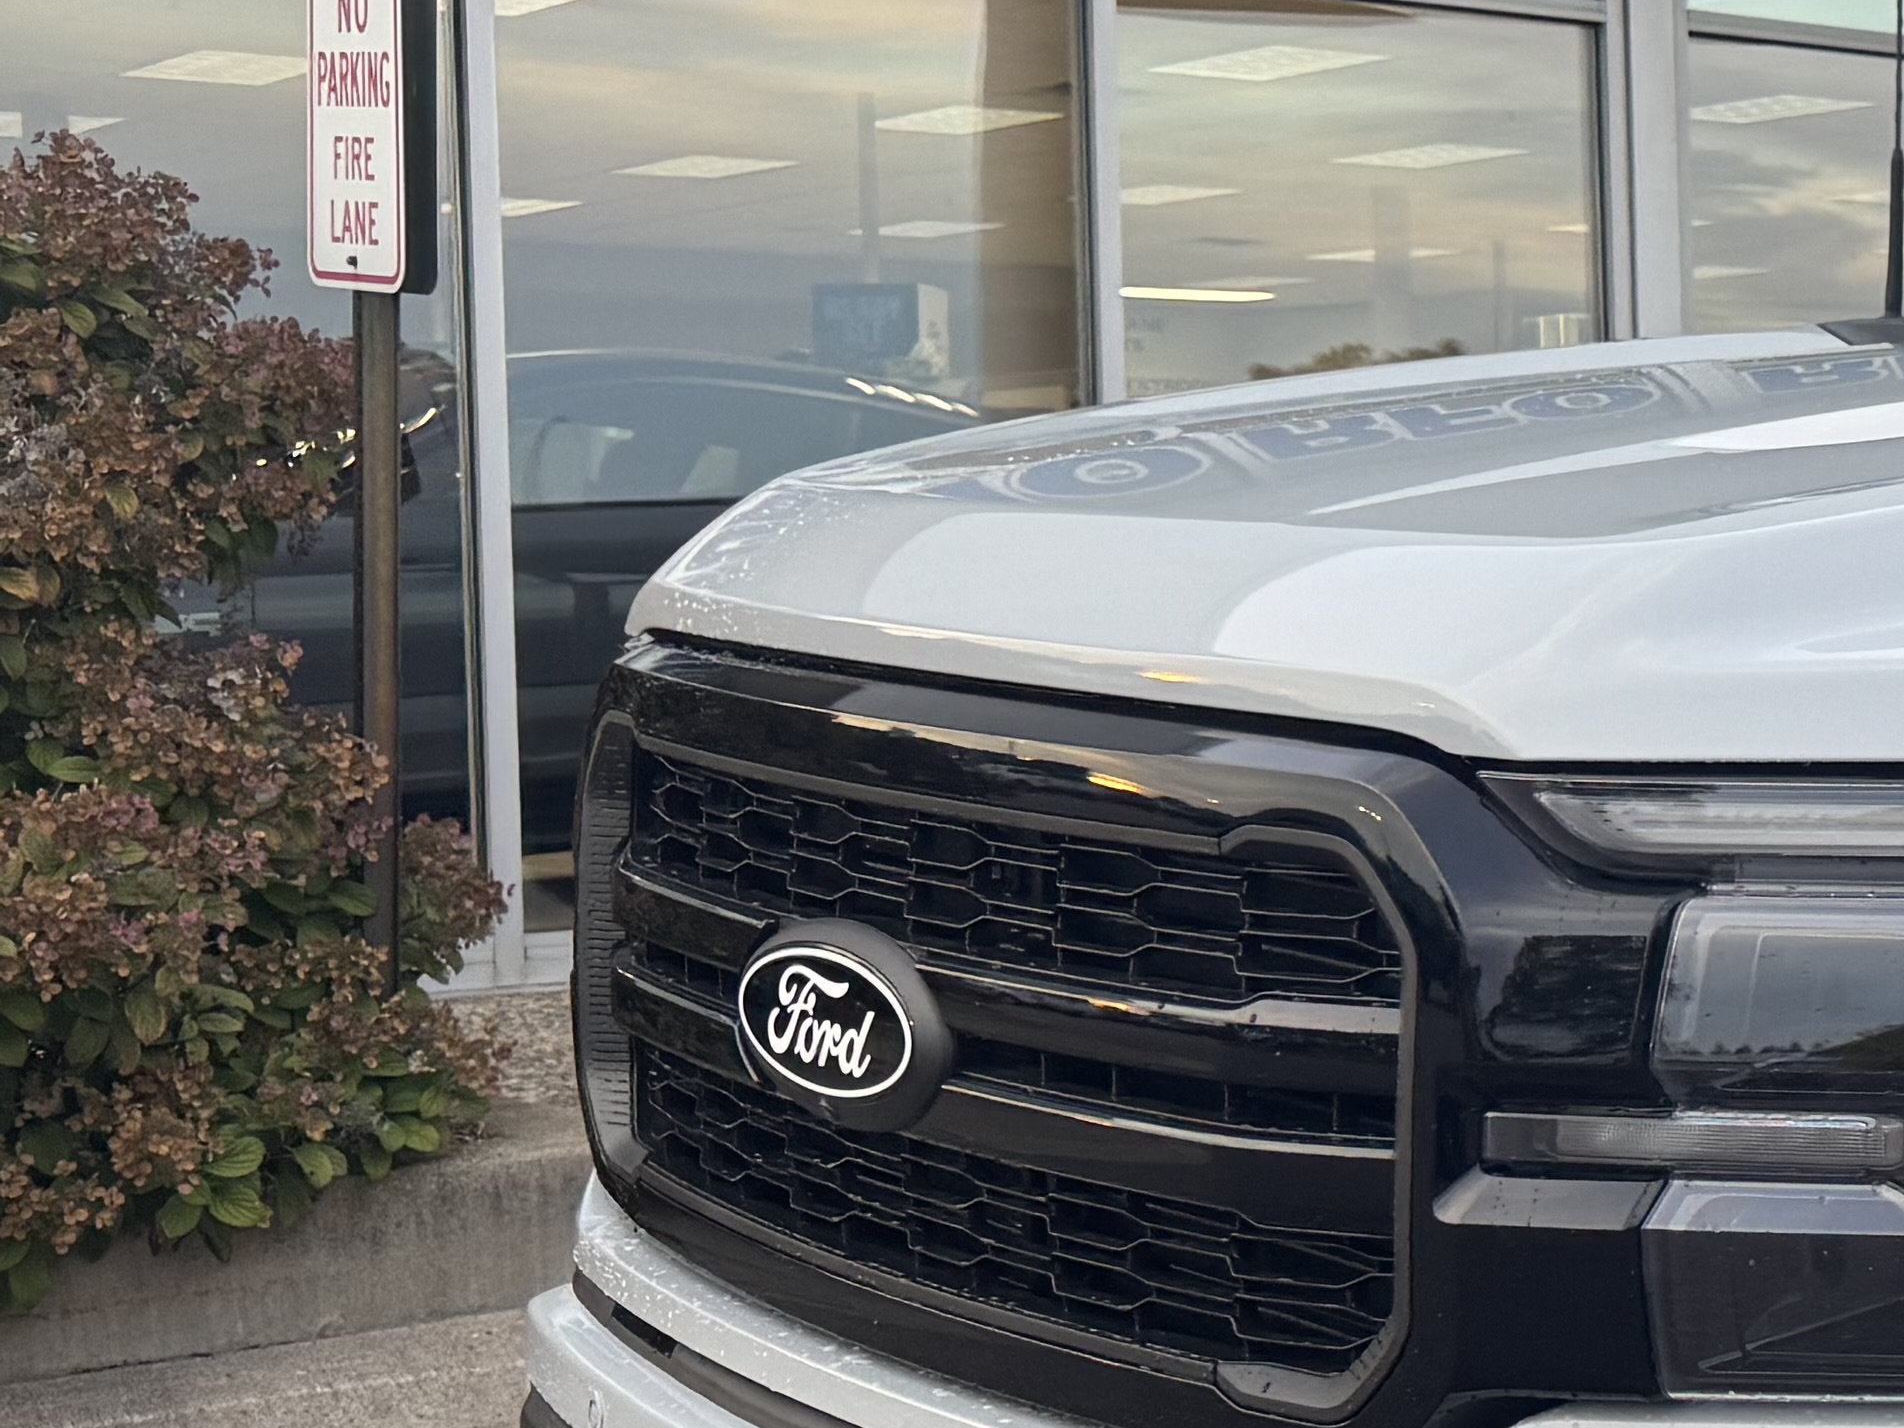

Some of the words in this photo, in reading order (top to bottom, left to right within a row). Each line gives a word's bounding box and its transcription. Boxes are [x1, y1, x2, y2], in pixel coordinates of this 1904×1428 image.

[317, 51, 390, 109] PARKING
[333, 136, 375, 181] FIRE
[331, 199, 379, 246] LANE
[767, 964, 876, 1078] Ford
